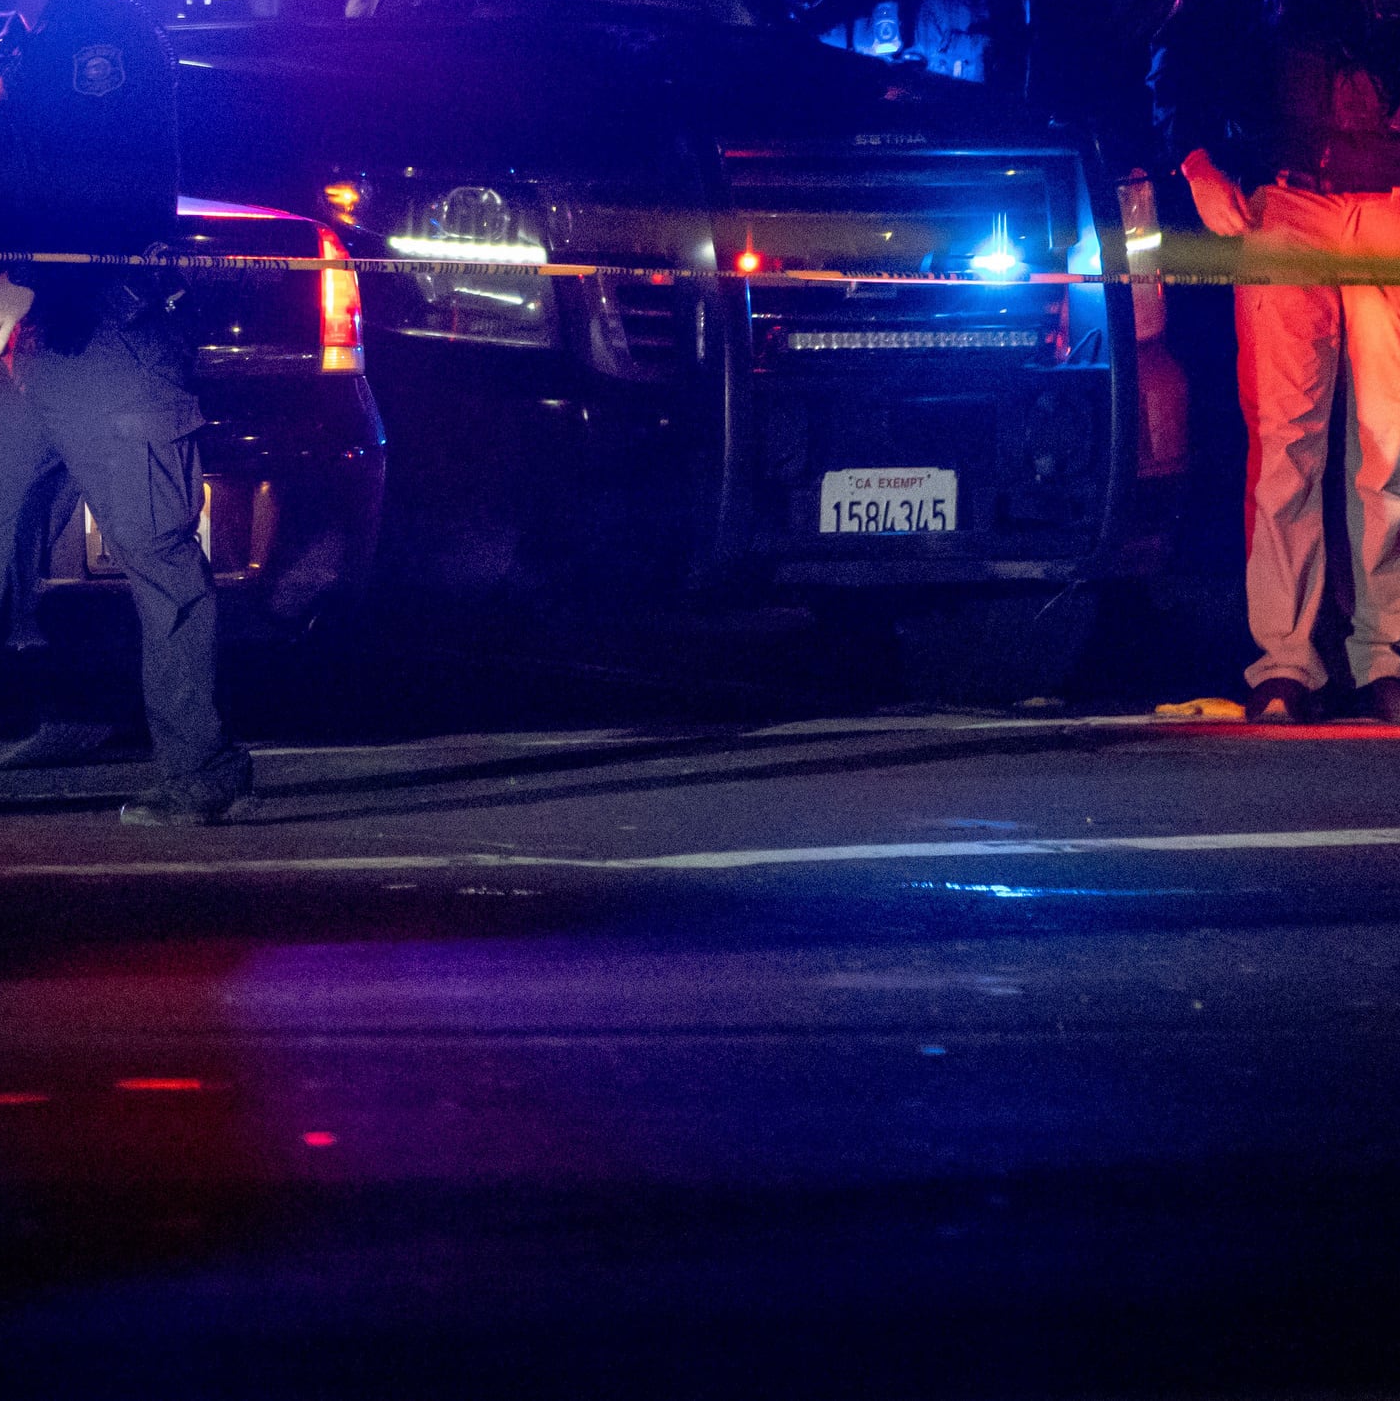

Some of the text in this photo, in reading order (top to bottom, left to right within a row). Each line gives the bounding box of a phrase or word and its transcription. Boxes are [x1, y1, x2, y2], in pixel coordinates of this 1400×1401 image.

[856, 477, 925, 489] CA EXEMPT
[833, 499, 946, 532] 1584345
